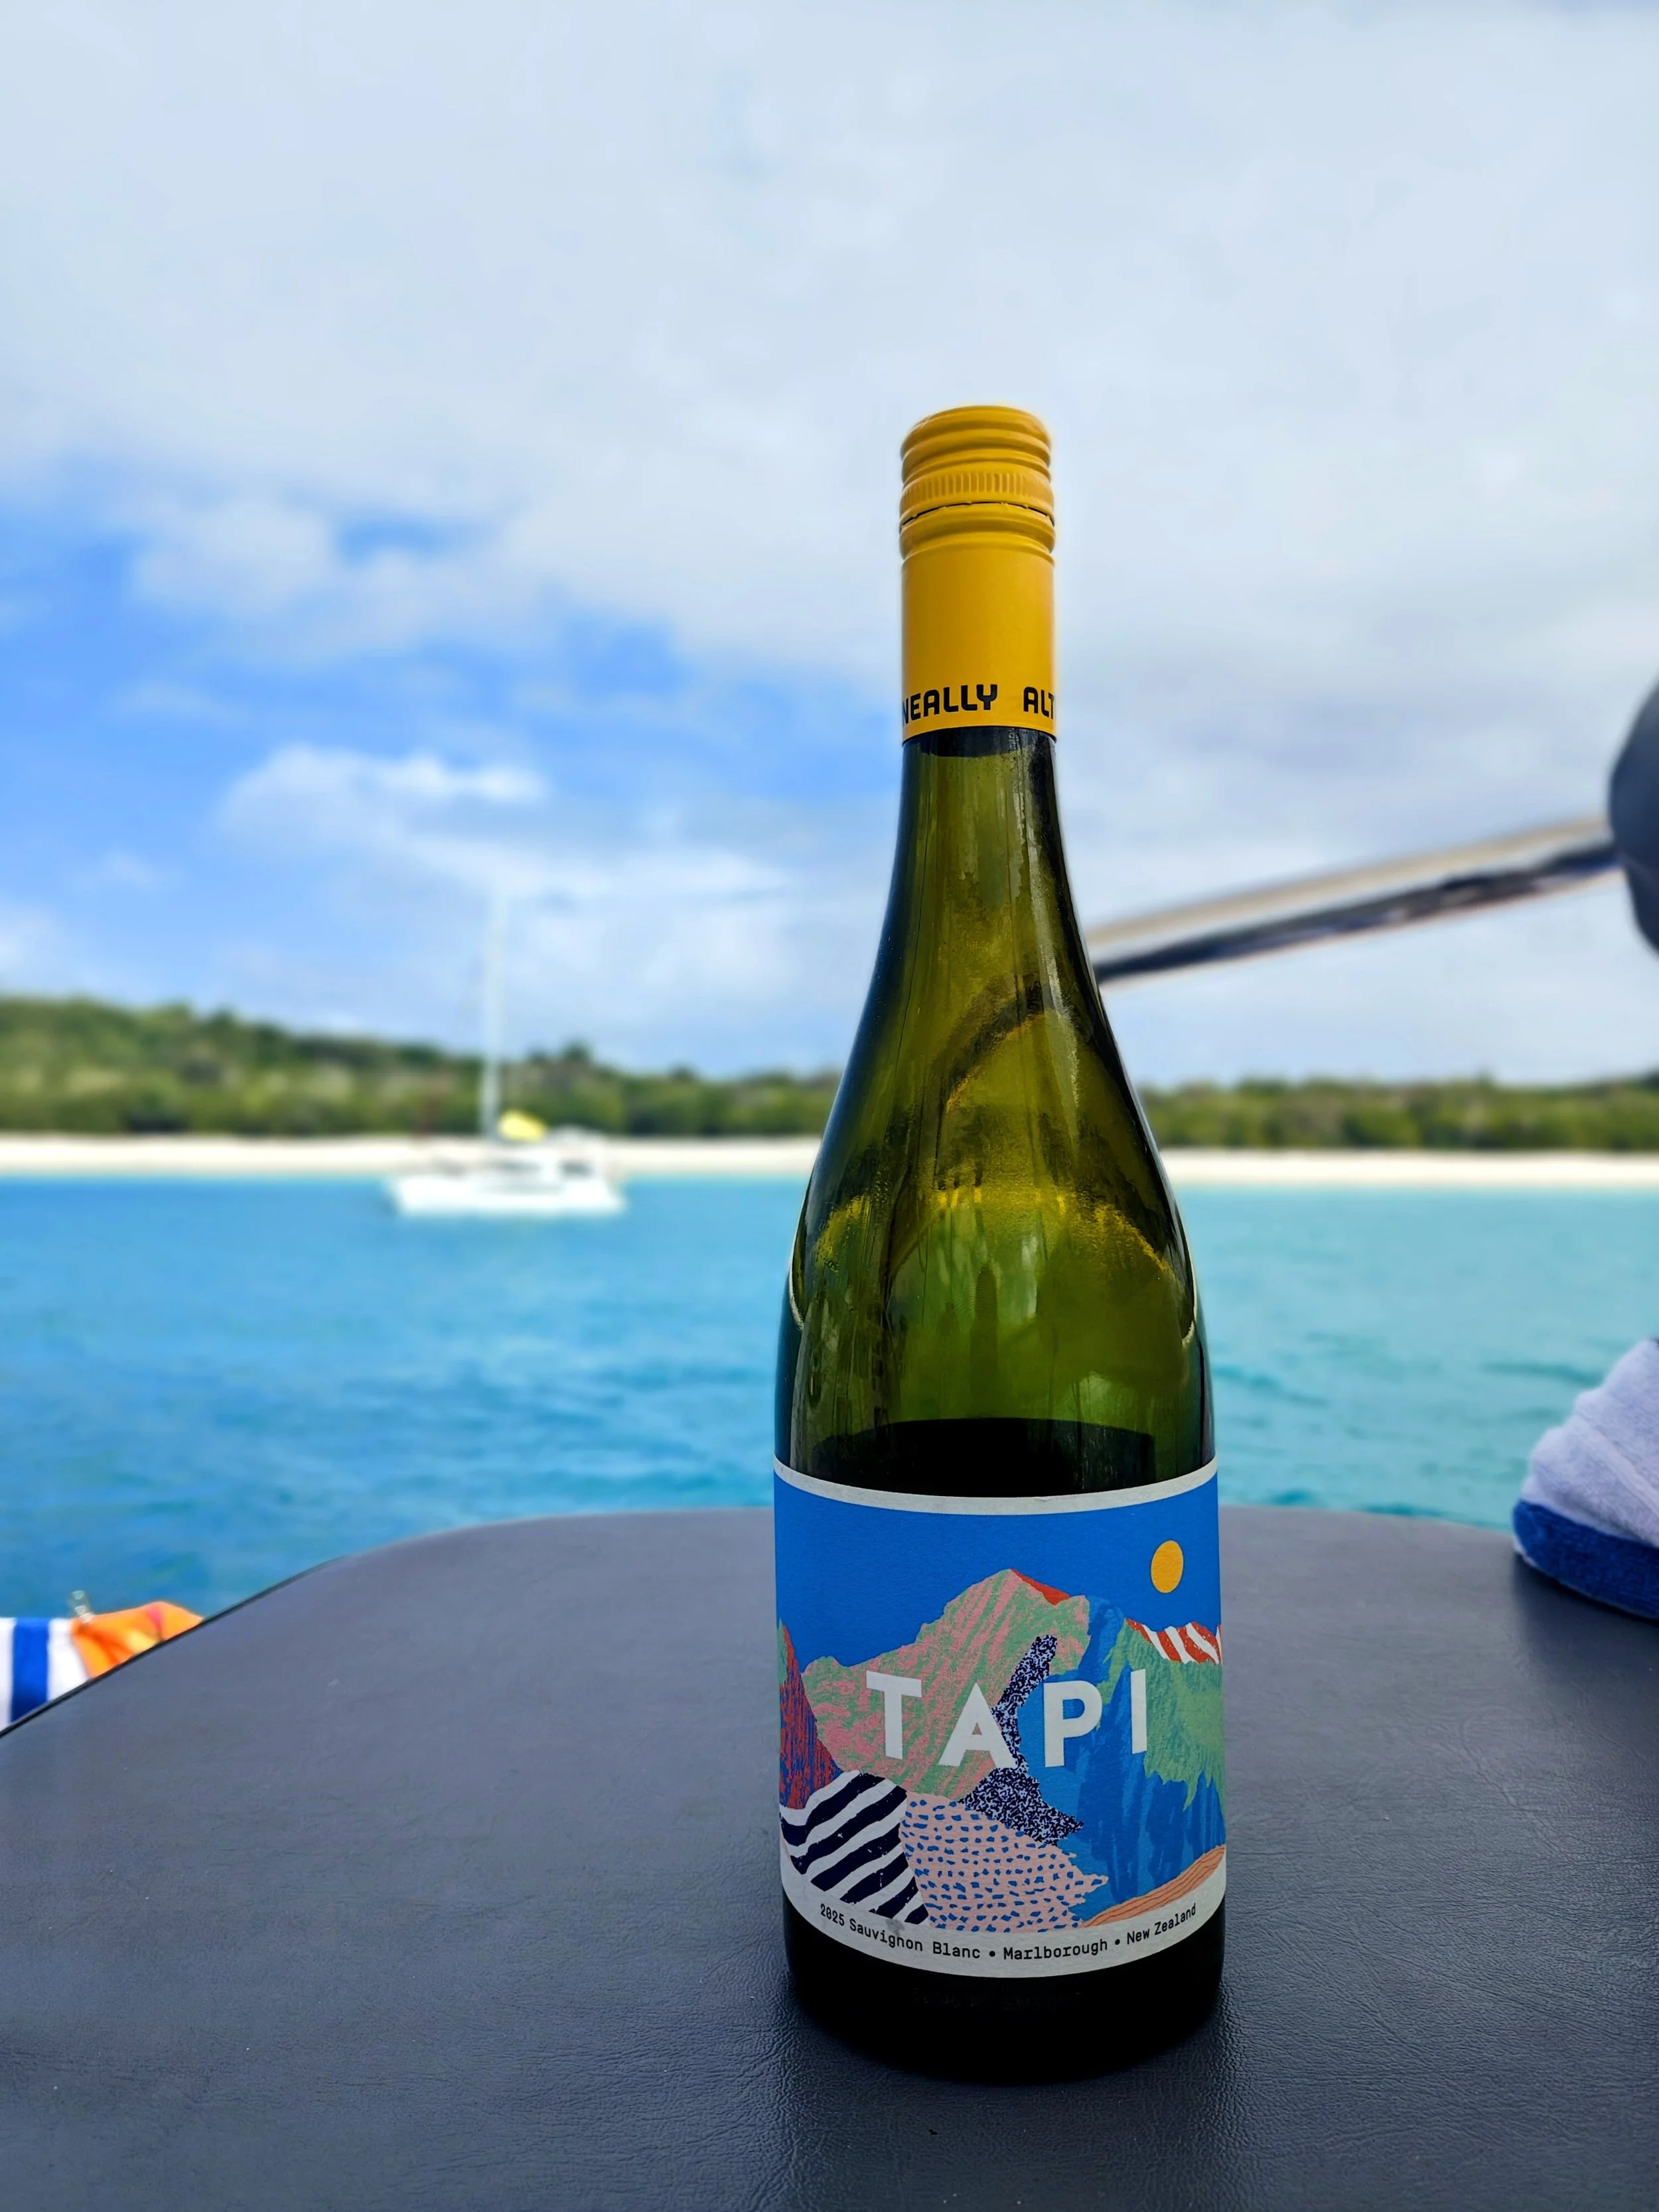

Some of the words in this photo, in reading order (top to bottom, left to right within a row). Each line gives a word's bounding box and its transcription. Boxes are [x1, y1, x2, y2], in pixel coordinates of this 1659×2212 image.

[865, 1669, 1147, 1770] TAPI
[820, 1903, 845, 1927] 2025
[849, 1917, 923, 1952] Sauvignon
[932, 1941, 981, 1959] Blanc
[1003, 1938, 1108, 1961] Marlborough
[1127, 1928, 1150, 1945] New
[1154, 1902, 1196, 1936] Zealand
